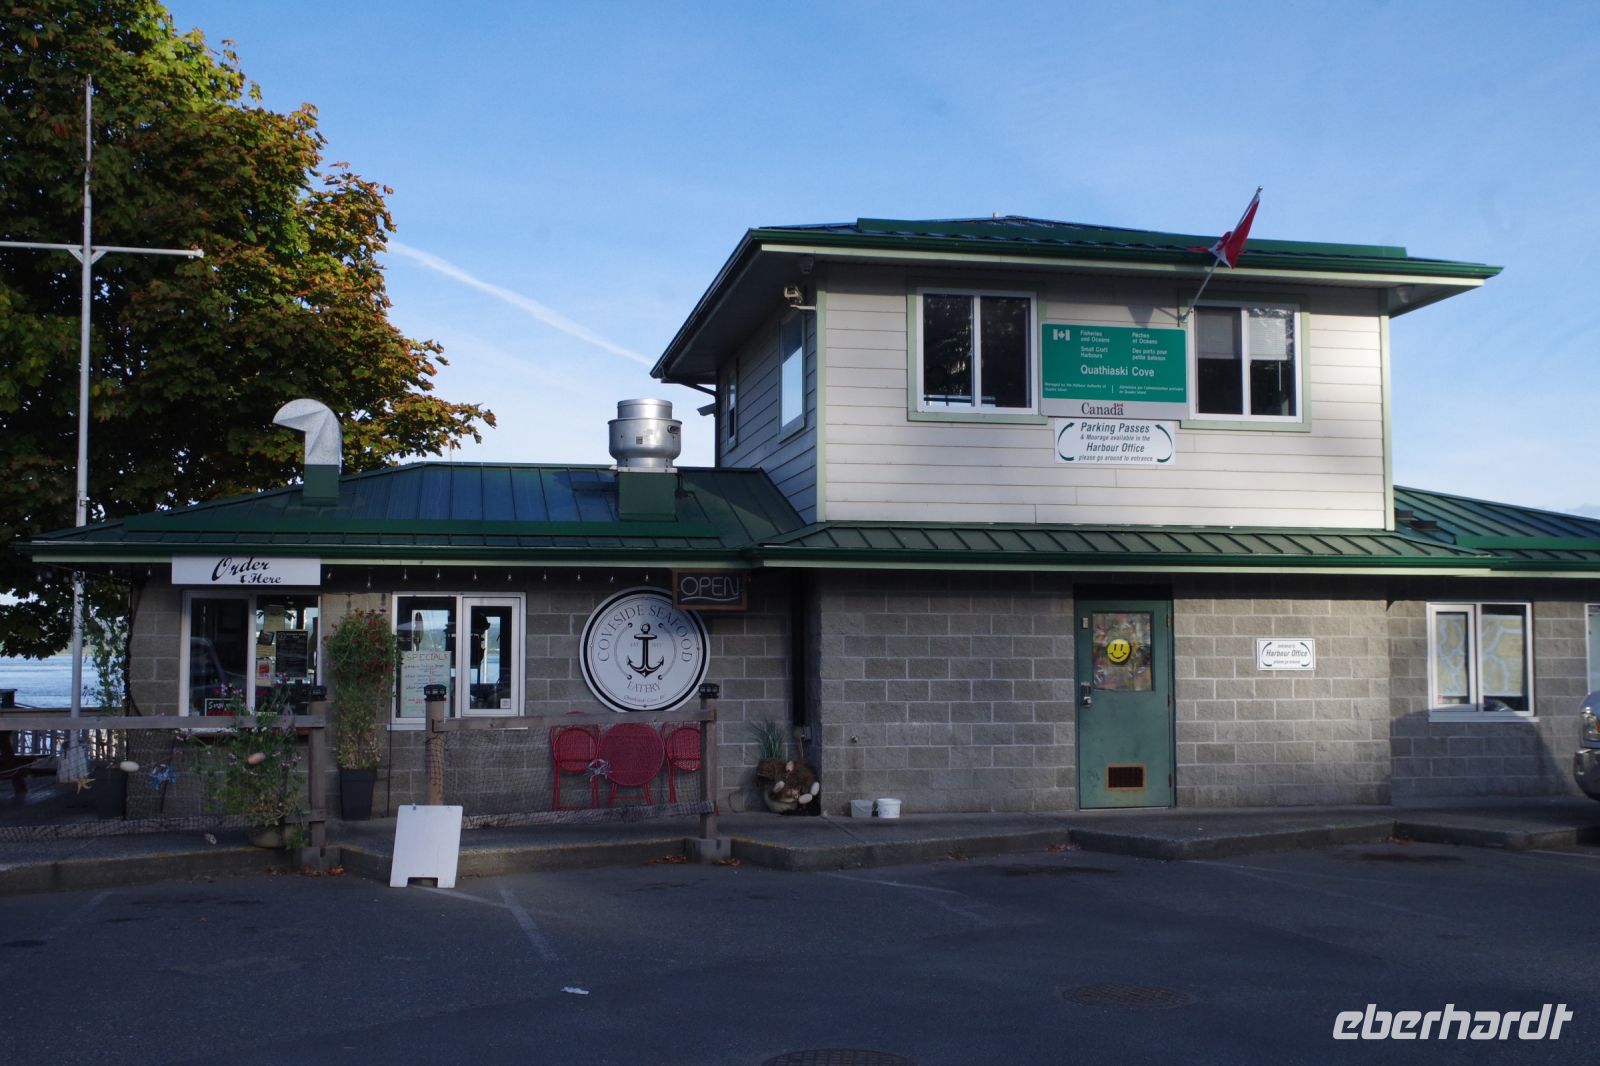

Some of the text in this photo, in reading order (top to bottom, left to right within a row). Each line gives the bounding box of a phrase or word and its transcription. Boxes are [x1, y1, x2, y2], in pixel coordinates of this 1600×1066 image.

[1080, 329, 1103, 337] Fisheries
[1080, 364, 1155, 377] Quathiaski Cove
[1081, 402, 1124, 415] Canada
[1080, 422, 1150, 434] Parking Passes
[1087, 442, 1145, 452] Harbour Office
[211, 556, 271, 581] Order
[248, 573, 282, 584] Here
[681, 576, 739, 597] OPEN
[598, 605, 693, 662] COVESIDE SEAFOOD
[627, 681, 661, 694] EATERY
